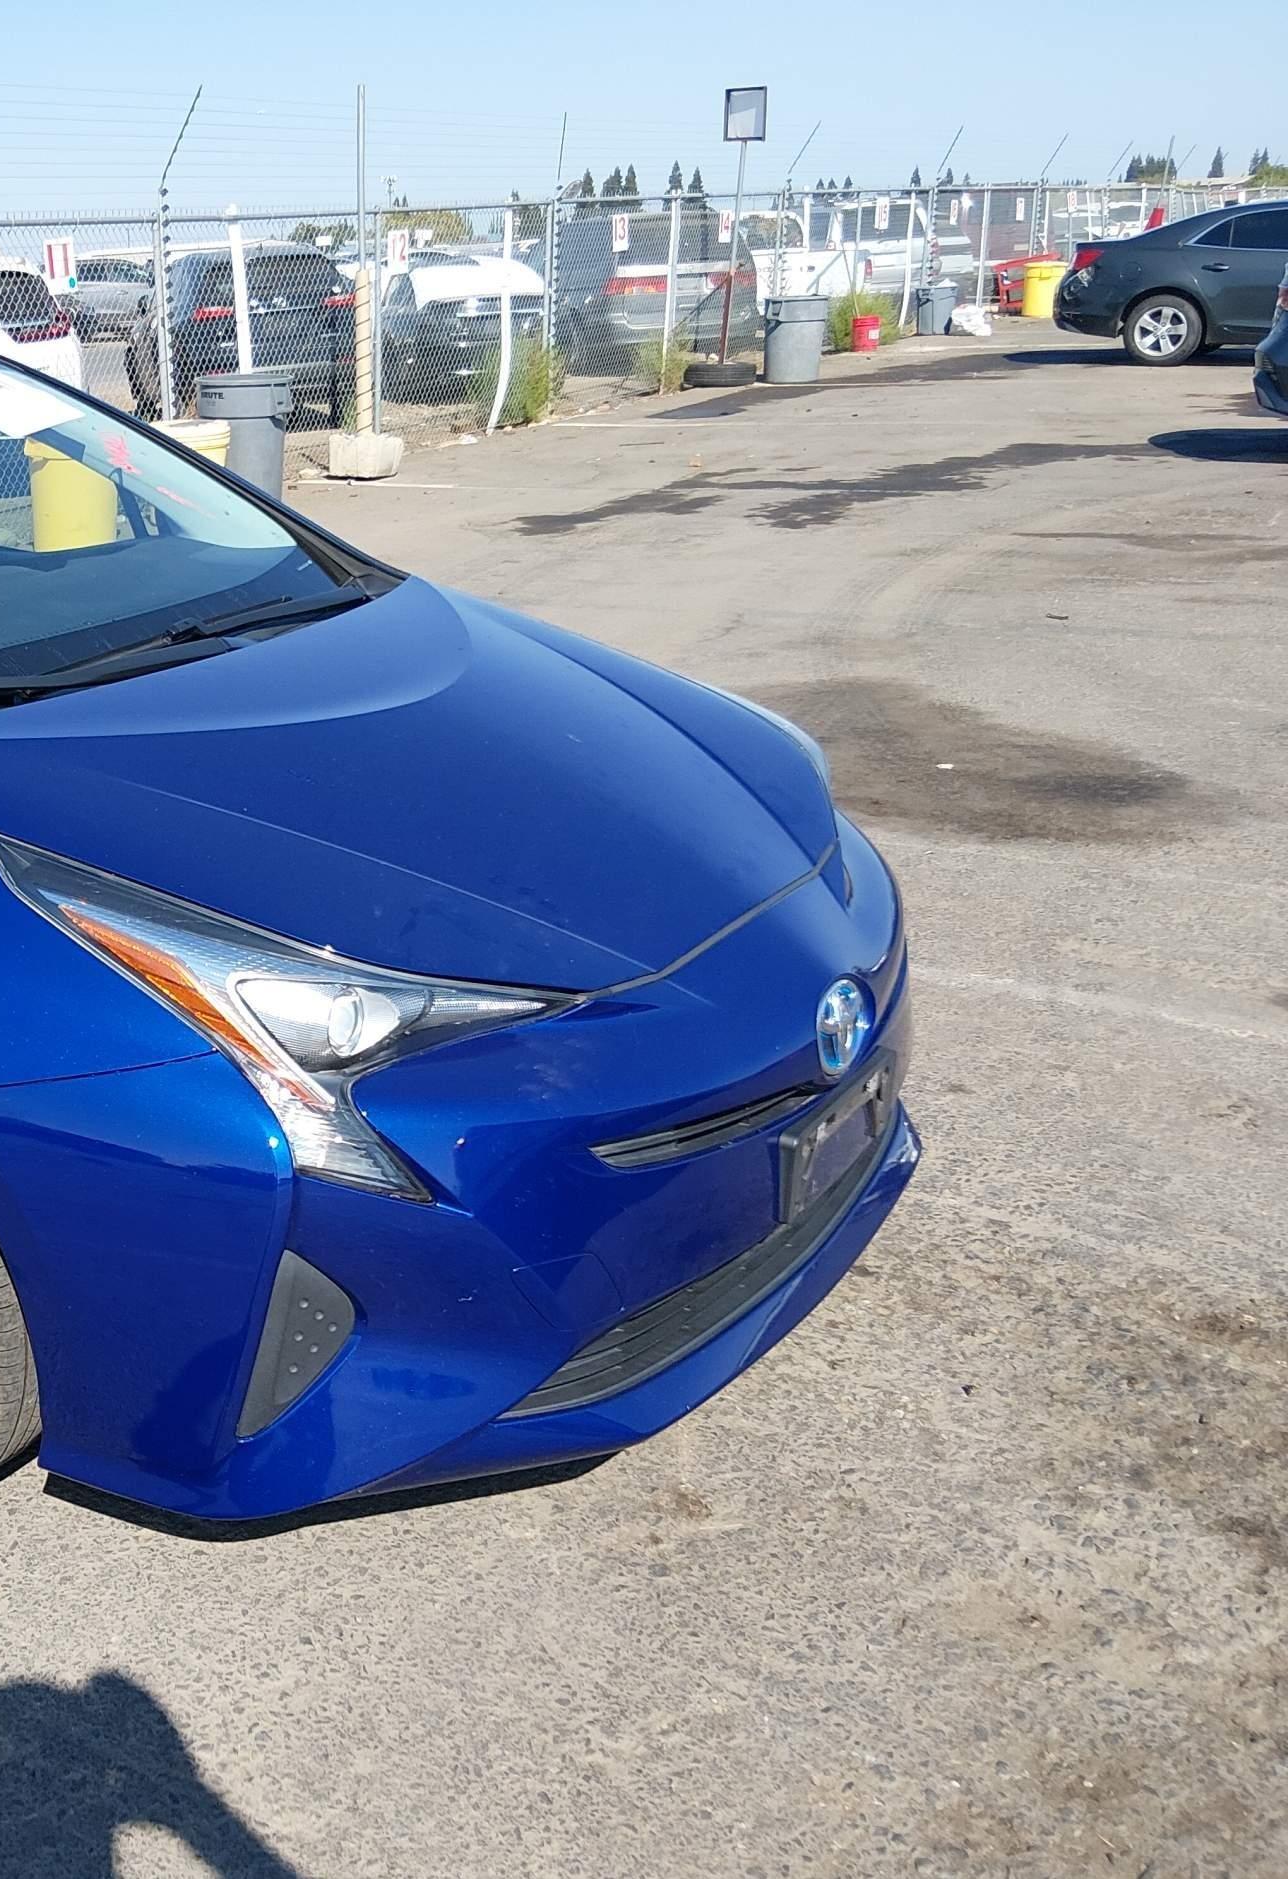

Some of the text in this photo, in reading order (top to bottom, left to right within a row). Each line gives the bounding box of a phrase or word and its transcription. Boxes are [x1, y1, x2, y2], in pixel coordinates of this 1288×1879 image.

[614, 216, 626, 241] 13
[720, 212, 730, 234] 14
[392, 233, 406, 262] 12
